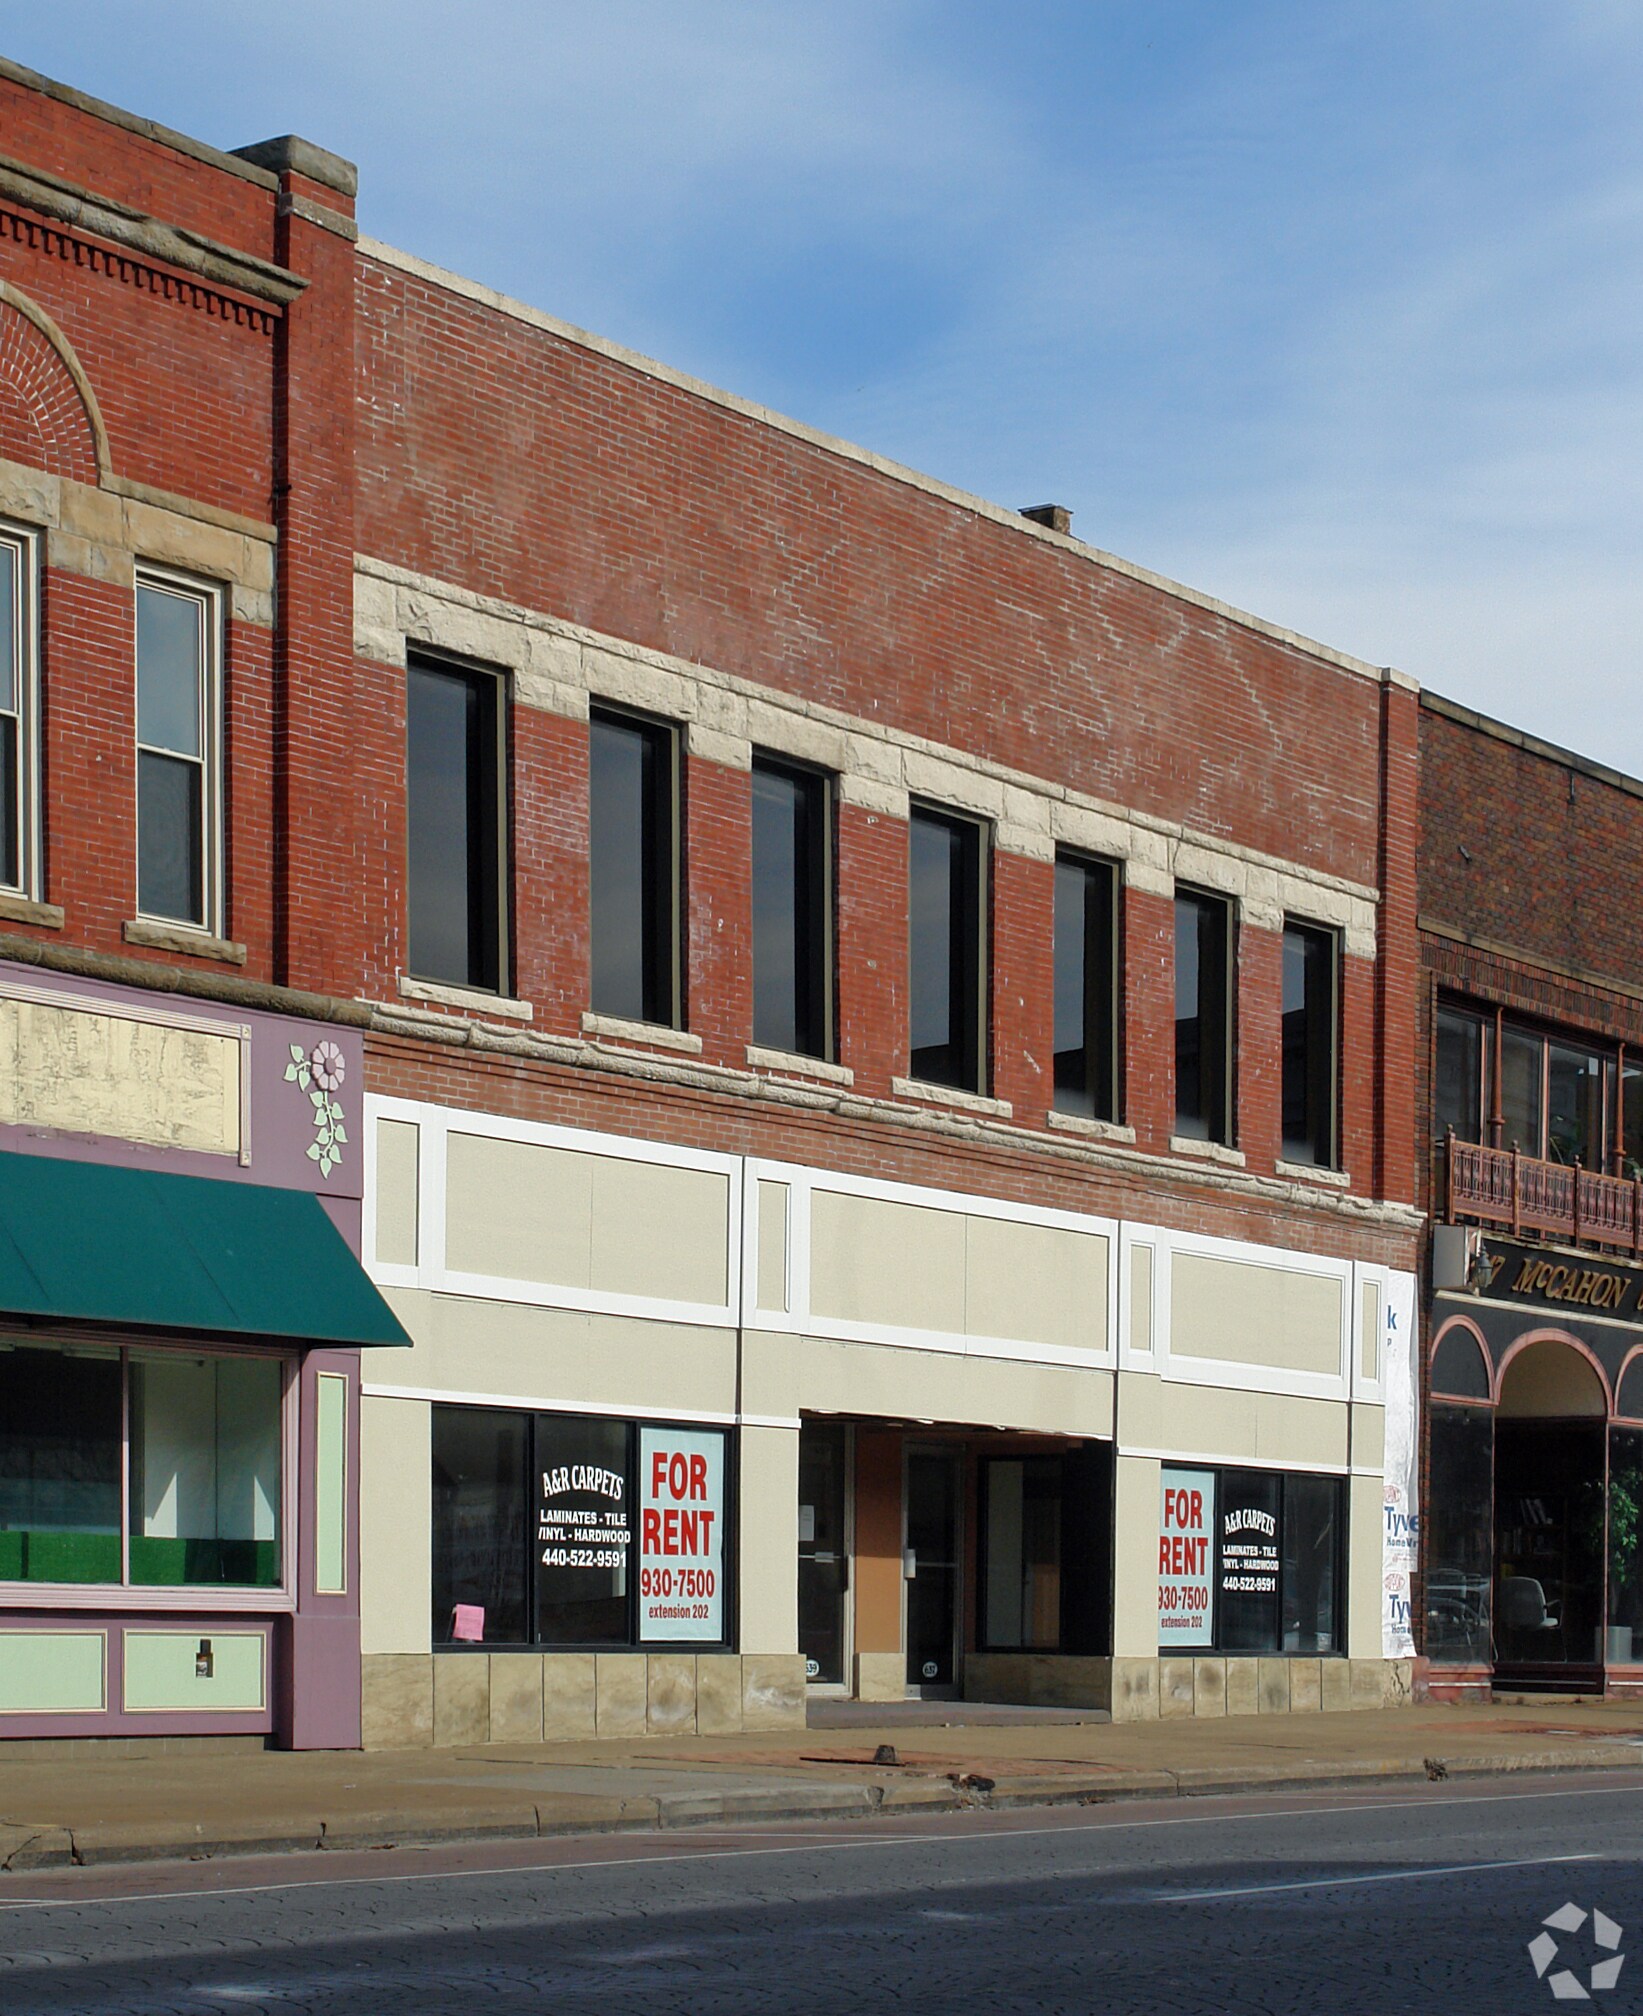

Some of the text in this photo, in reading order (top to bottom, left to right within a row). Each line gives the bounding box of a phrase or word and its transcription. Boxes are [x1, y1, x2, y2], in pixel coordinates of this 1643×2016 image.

[542, 1465, 624, 1500] A&R CARPETS
[652, 1452, 707, 1500] FOR
[540, 1509, 597, 1525] LAMINATES
[604, 1512, 627, 1526] TILE
[1164, 1488, 1203, 1529] FOR
[642, 1508, 715, 1556] RENT
[1224, 1508, 1276, 1537] A&R CARPETS
[574, 1528, 631, 1544] HARDWOOD
[542, 1548, 627, 1567] 440-522-9591
[1159, 1536, 1209, 1576] RENT
[1222, 1544, 1258, 1557] LAMINATES
[1262, 1546, 1277, 1557] TILE
[1243, 1559, 1279, 1571] HARDWOOD
[641, 1568, 715, 1598] 930-7500
[1222, 1576, 1276, 1592] 440-522-9591
[649, 1603, 709, 1619] extension 202
[1161, 1615, 1203, 1629] extension 202
